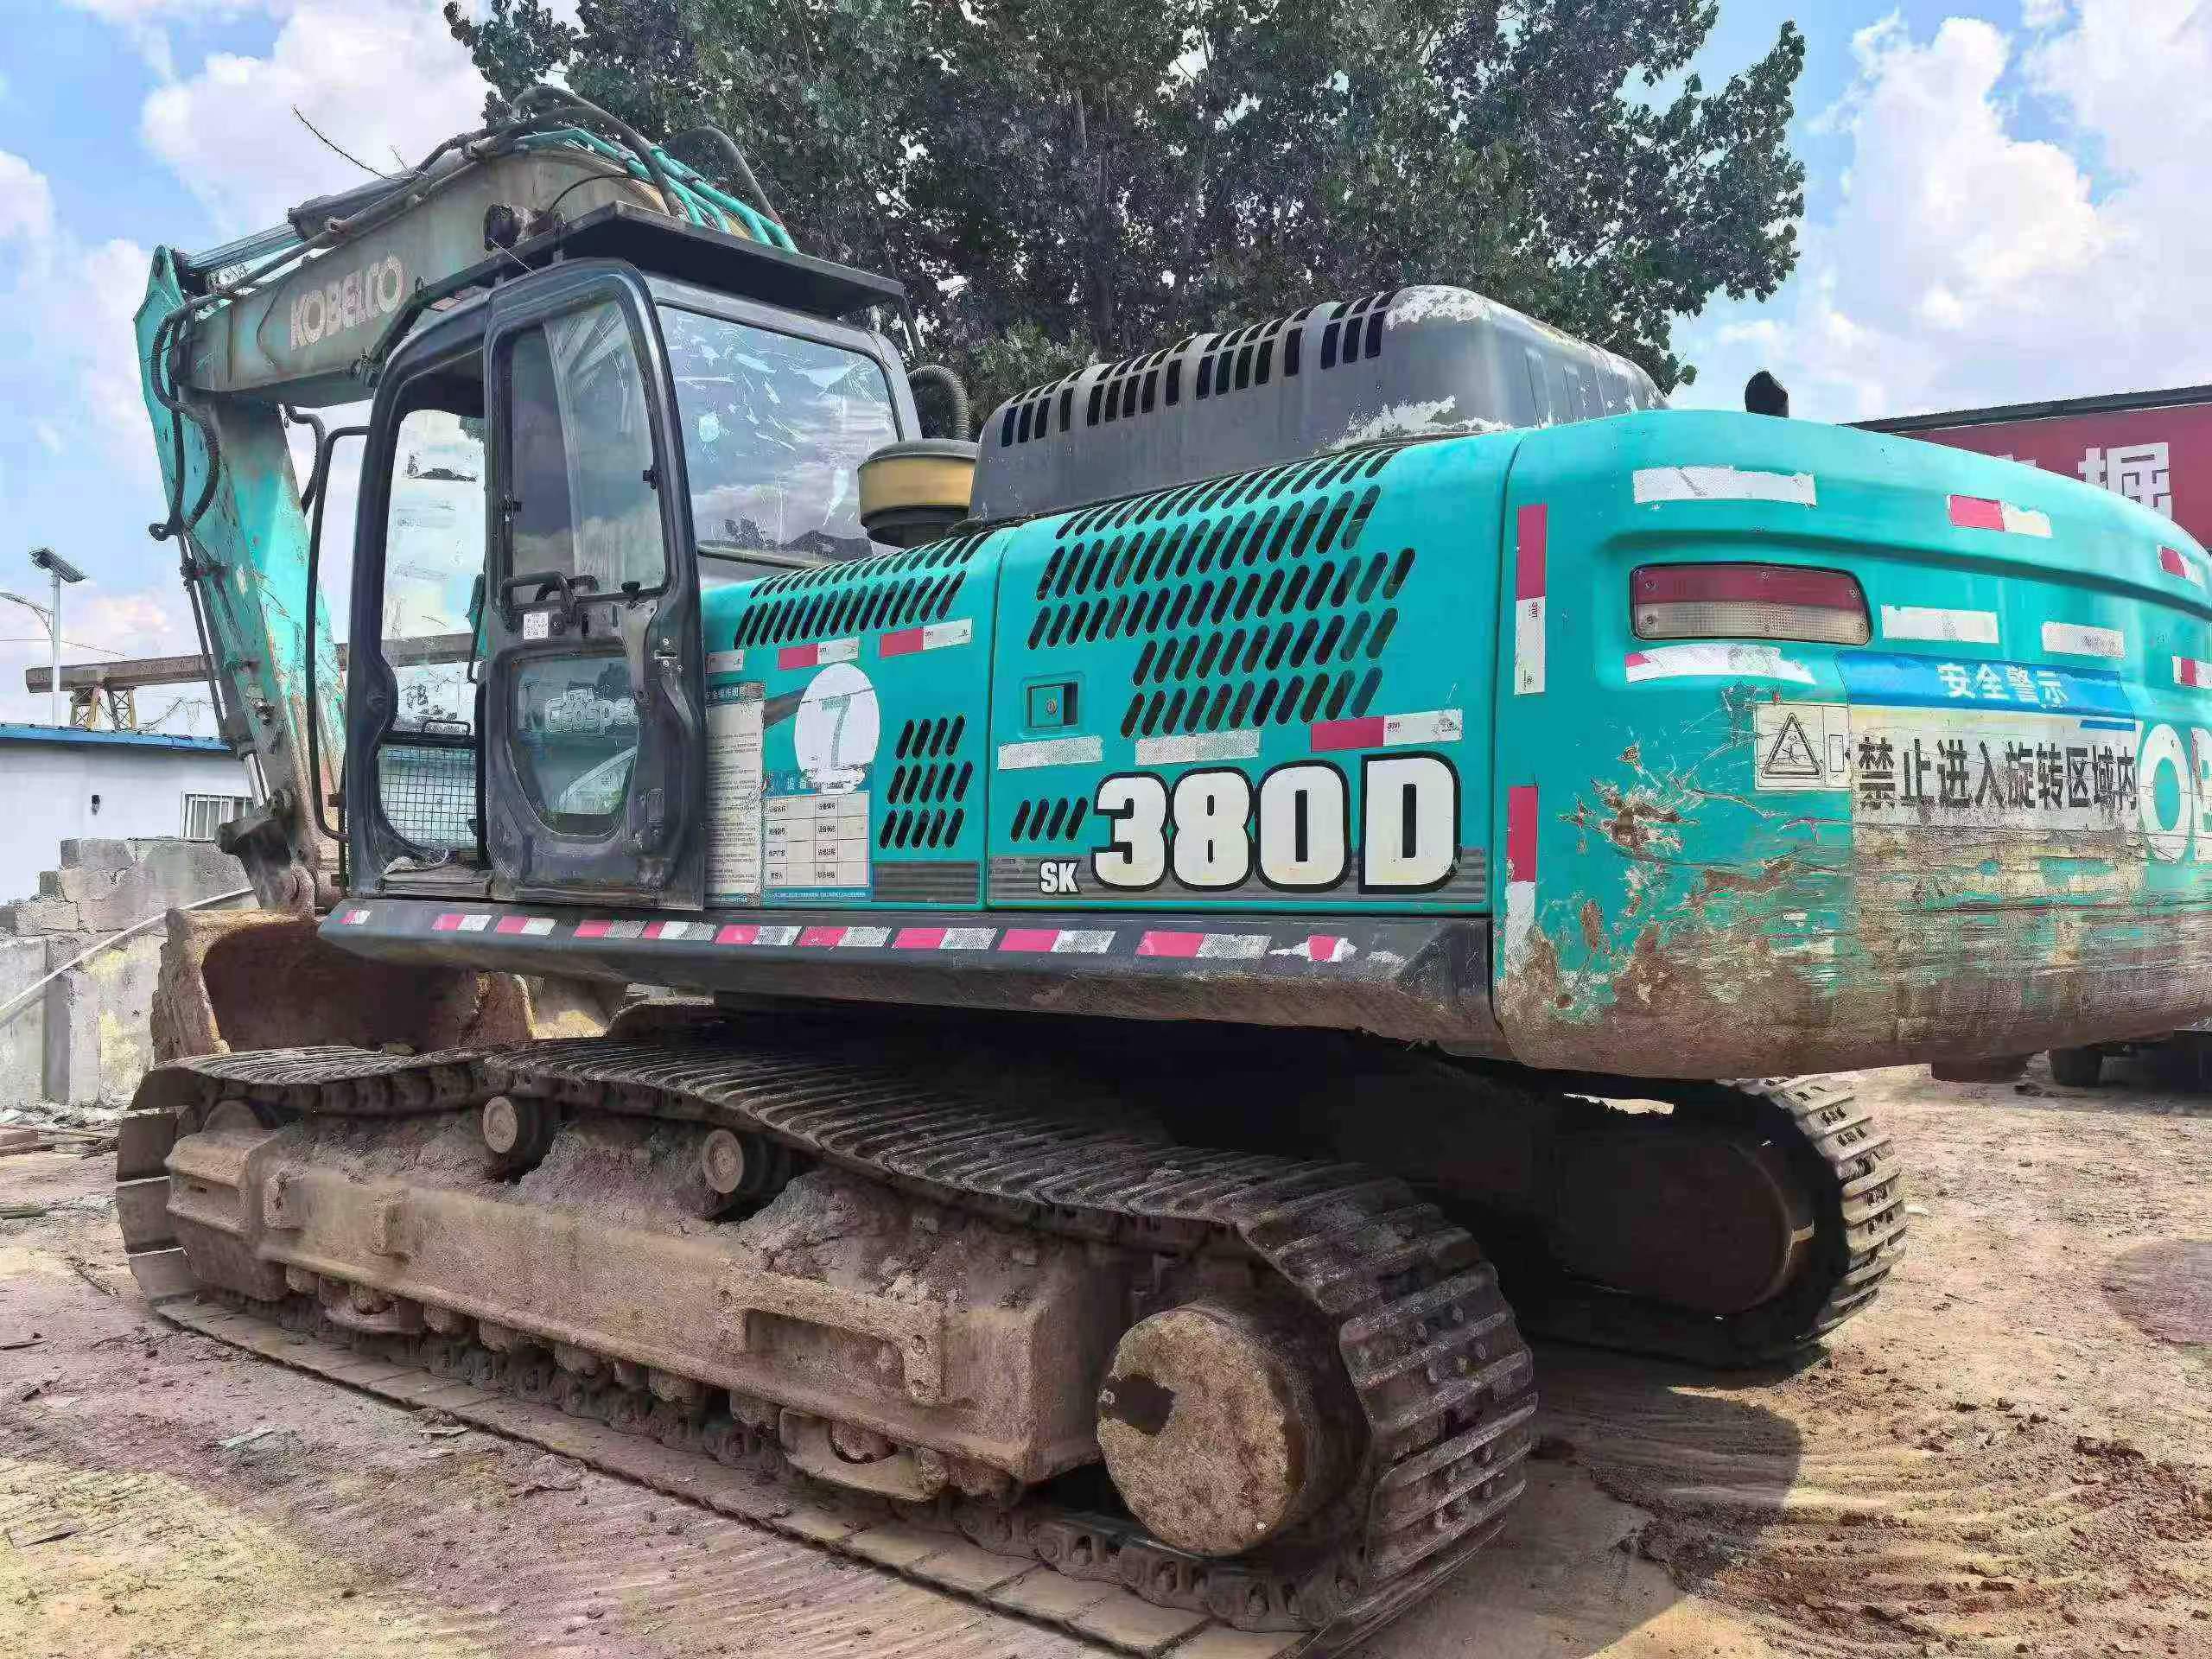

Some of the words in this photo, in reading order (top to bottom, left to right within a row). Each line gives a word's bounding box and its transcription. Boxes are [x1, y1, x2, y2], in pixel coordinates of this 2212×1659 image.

[1936, 662, 2068, 709] 安全警示
[1858, 736, 2139, 810] 禁止进入旋转区域内
[1039, 861, 1079, 893] SK
[1091, 752, 1461, 893] 380D
